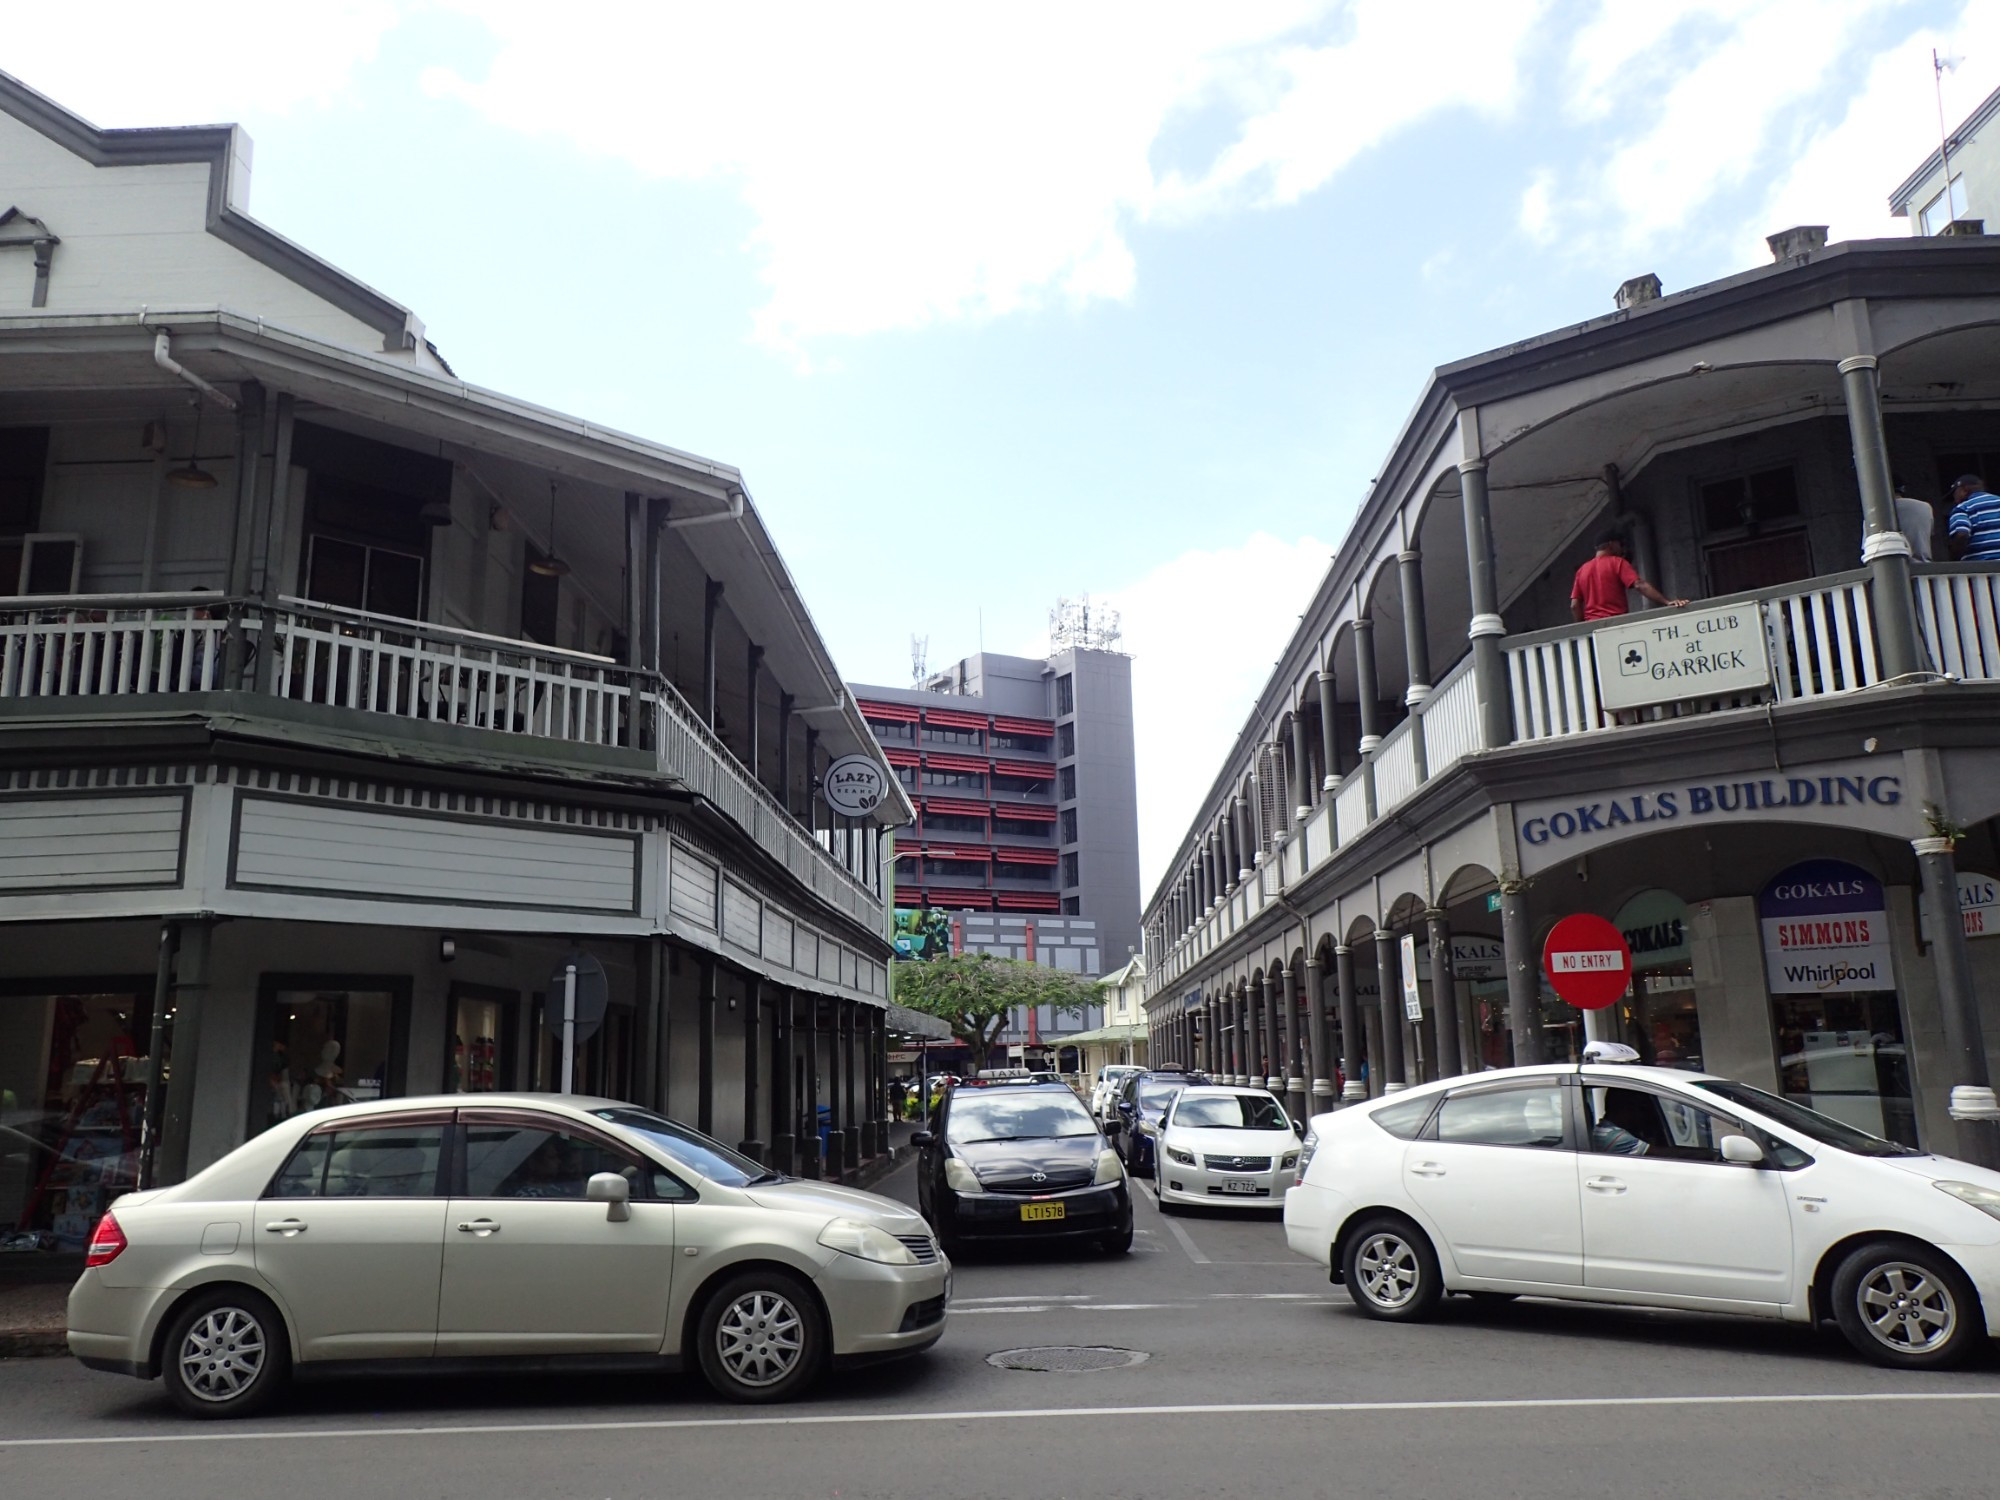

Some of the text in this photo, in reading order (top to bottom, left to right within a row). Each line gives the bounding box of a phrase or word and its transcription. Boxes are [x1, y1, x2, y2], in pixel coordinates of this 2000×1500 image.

[1652, 615, 1739, 641] TH CLUB
[1685, 640, 1703, 654] at
[1651, 650, 1746, 680] GARRICK
[835, 772, 876, 784] LAZY
[1522, 776, 1901, 845] GOKALS BUILDING
[1774, 880, 1864, 900] GOKALS
[1957, 882, 1994, 906] ALS
[1778, 920, 1870, 946] SIMMONS
[1427, 944, 1502, 960] KALS
[1562, 954, 1612, 968] NO ENTRY
[1784, 962, 1876, 985] Whirlpool
[989, 1070, 1021, 1078] TAXI
[1027, 1206, 1063, 1219] LT1578
